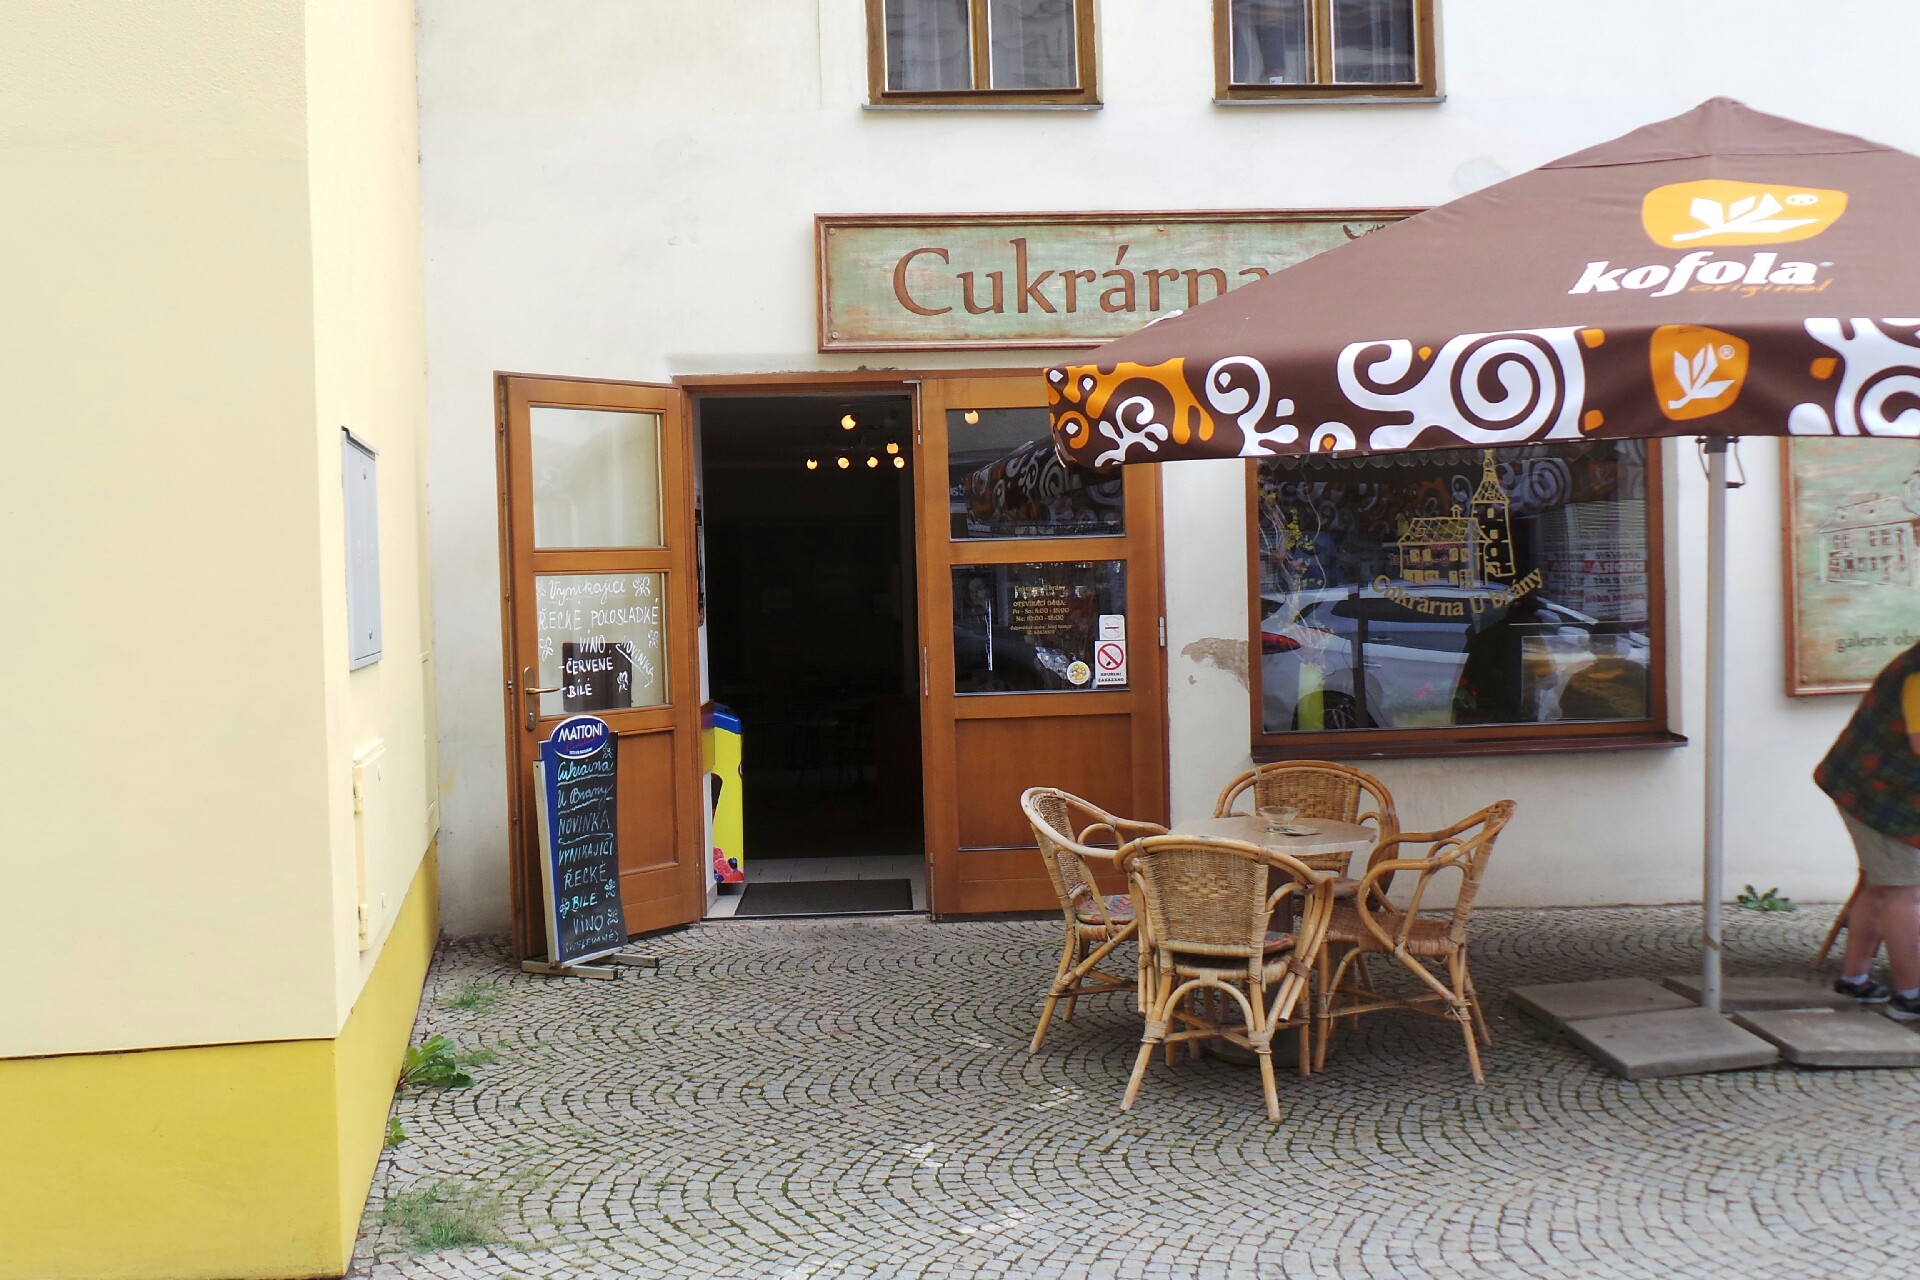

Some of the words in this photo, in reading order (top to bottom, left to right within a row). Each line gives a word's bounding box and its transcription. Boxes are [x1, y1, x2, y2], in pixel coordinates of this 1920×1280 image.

[1568, 251, 1818, 297] kofola
[1371, 574, 1465, 617] Cukrárna
[1469, 596, 1486, 614] U
[1490, 567, 1544, 609] brány
[579, 629, 606, 654] VÍNO
[558, 723, 603, 743] MATTONI
[558, 809, 610, 836] NOVINKA
[573, 914, 604, 936] VÍNO
